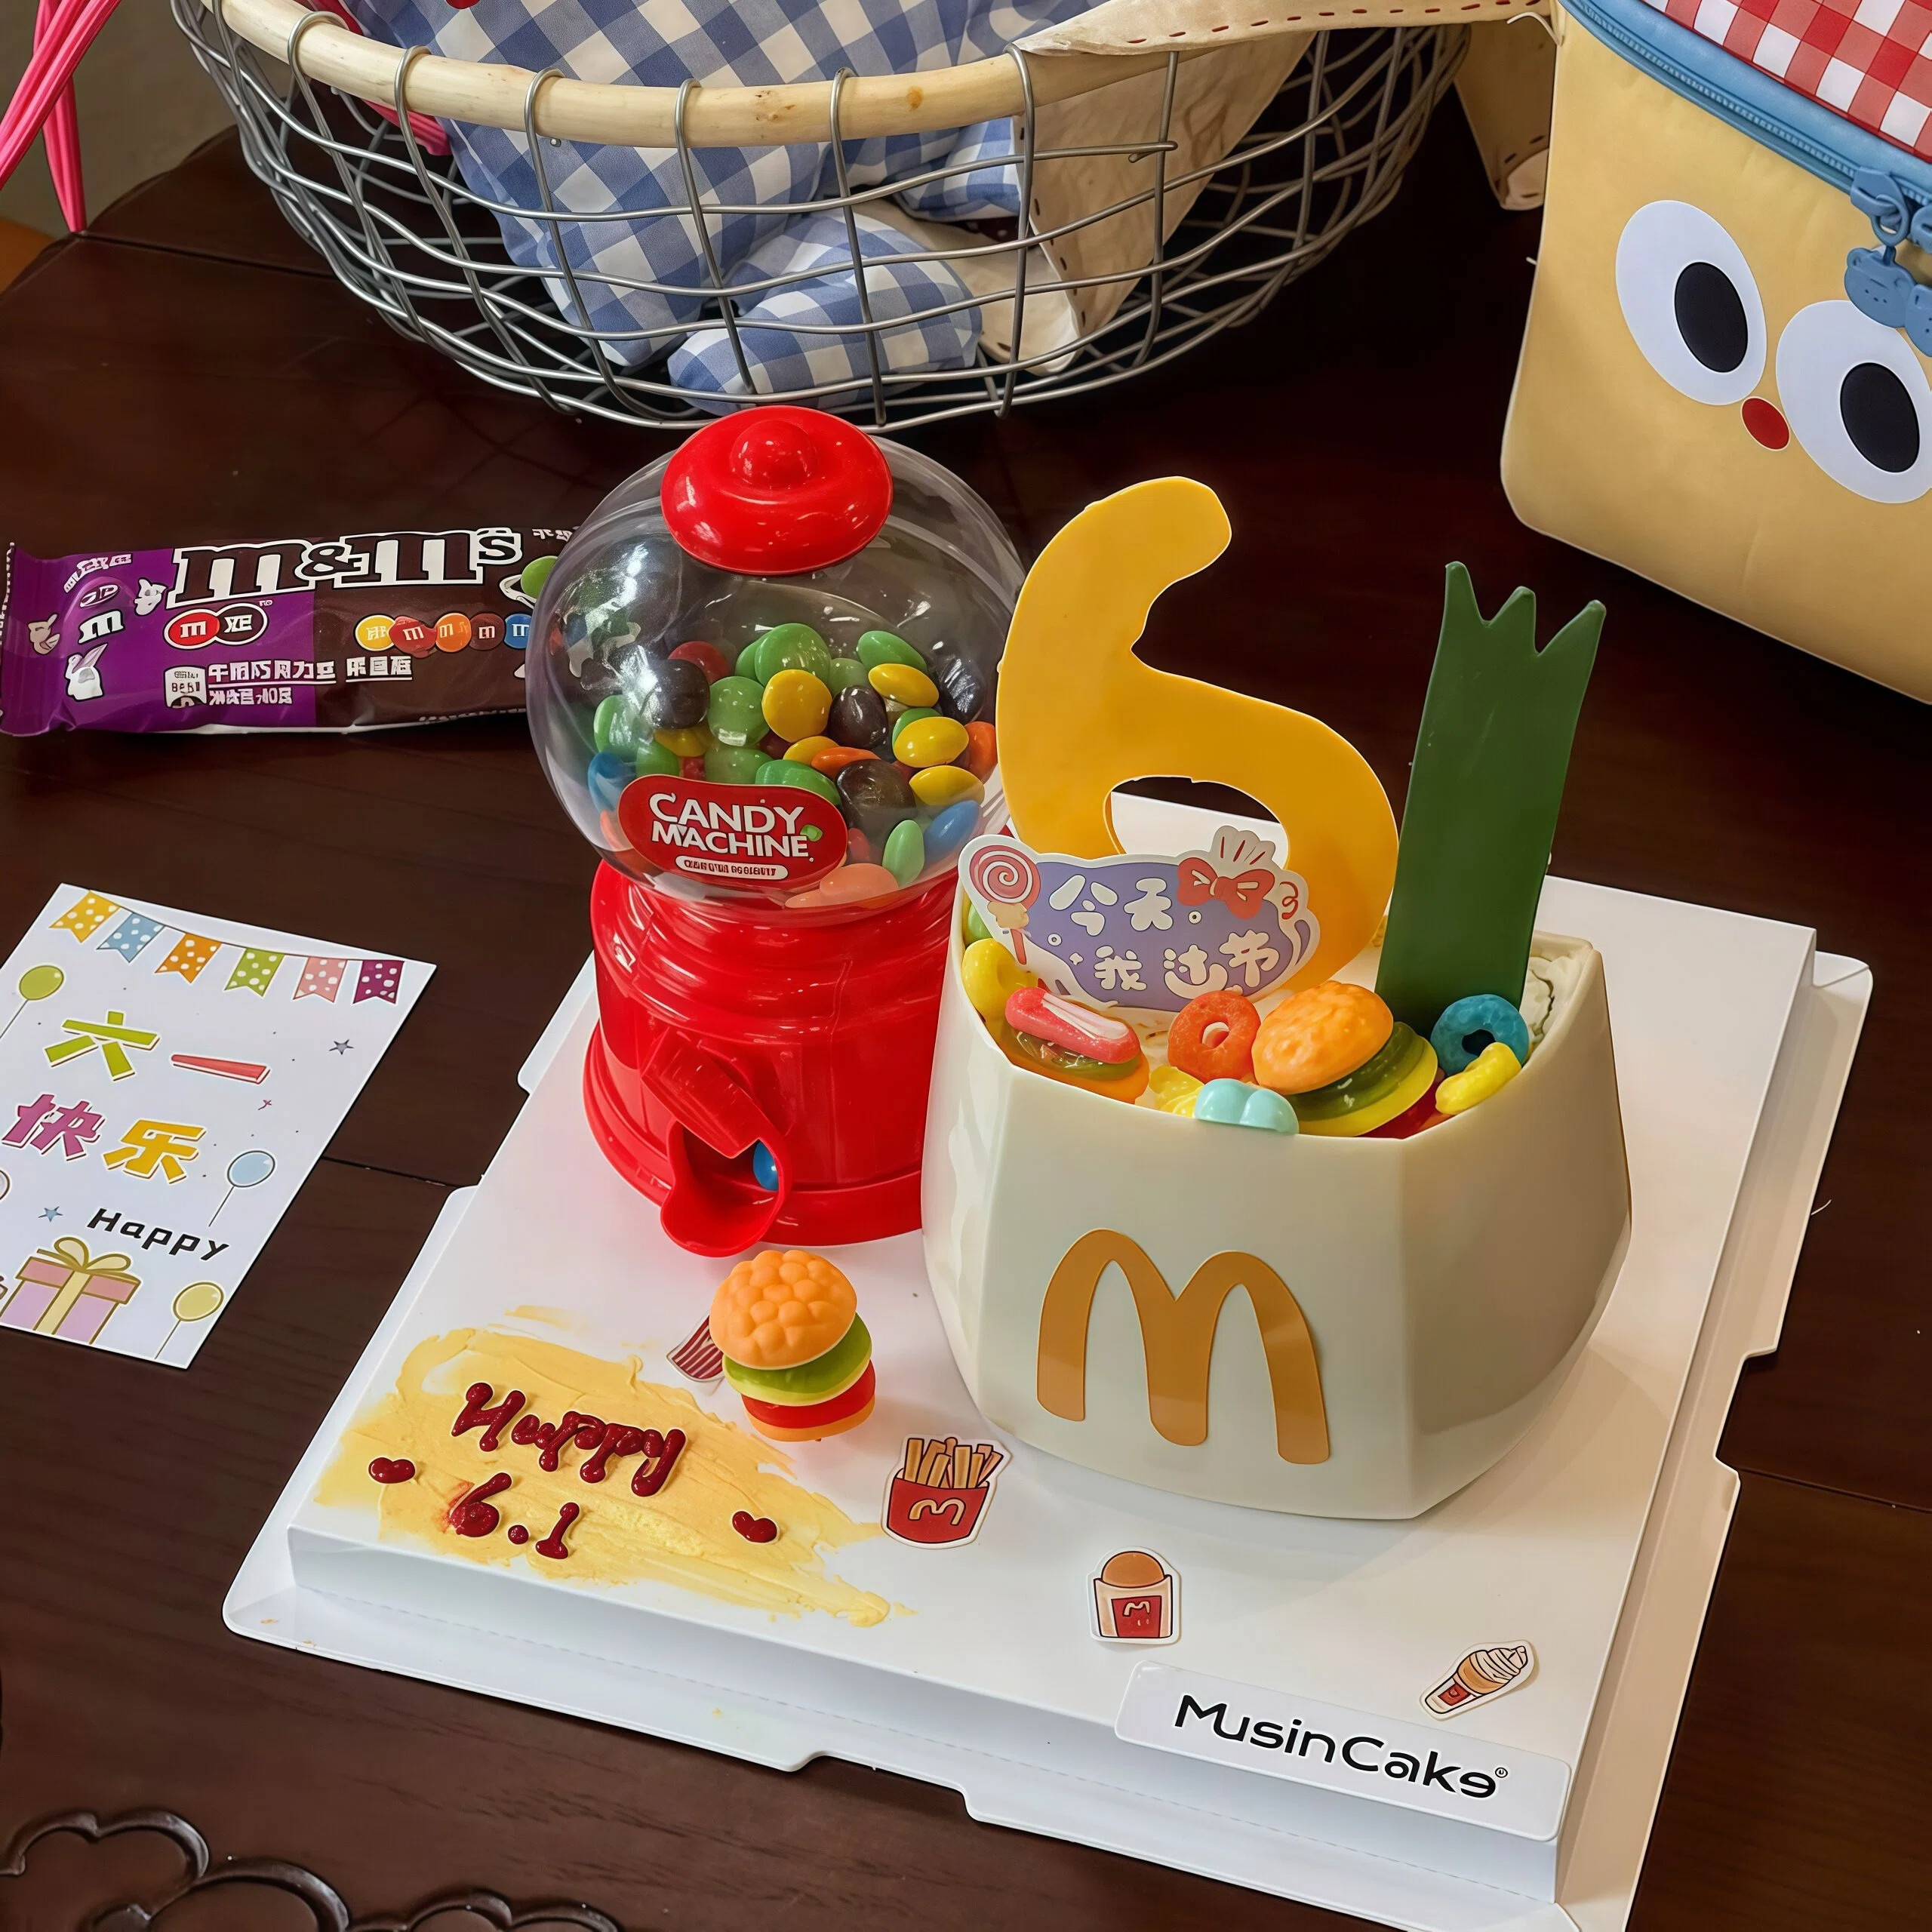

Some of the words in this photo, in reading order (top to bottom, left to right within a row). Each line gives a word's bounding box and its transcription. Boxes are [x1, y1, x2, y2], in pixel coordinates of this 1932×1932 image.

[648, 792, 805, 835] CANDY
[651, 820, 810, 858] MACHINE
[1048, 873, 1175, 937] 今天
[1093, 928, 1281, 1001] 我过节
[42, 1011, 271, 1085] 六一
[1, 1094, 207, 1185] 快乐
[87, 1208, 229, 1261] Happy
[451, 1382, 686, 1497] Happy
[450, 1472, 580, 1560] 6.1
[1174, 1694, 1497, 1798] MusinCake
